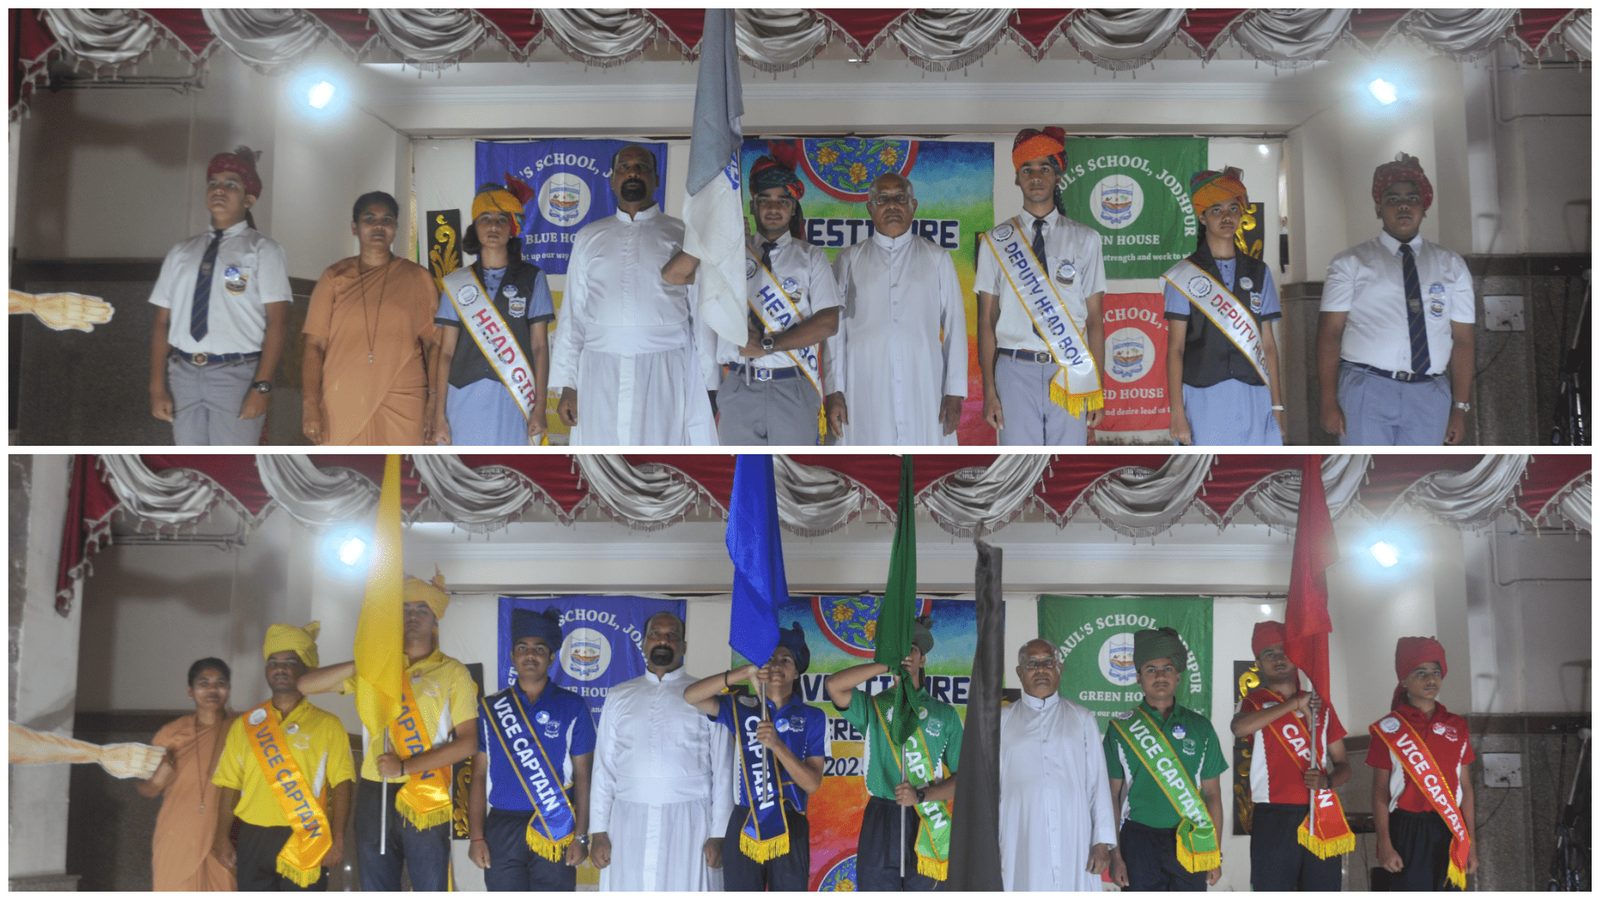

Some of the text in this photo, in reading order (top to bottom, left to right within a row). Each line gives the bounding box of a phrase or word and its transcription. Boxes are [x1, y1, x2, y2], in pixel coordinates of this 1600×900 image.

[535, 153, 600, 175] SCHOOL,
[1087, 155, 1153, 176] SCHOOL,
[1156, 169, 1197, 237] JODHPUR
[525, 232, 557, 245] BLUE
[1117, 234, 1160, 245] HOUSE
[1137, 252, 1151, 260] and
[756, 284, 793, 328] HEA
[1004, 242, 1083, 367] DEPUTY HEAD BOY
[1103, 307, 1163, 329] CHOOL,
[1210, 293, 1256, 342] DEPUTY
[472, 308, 516, 365] HEAD
[1120, 388, 1164, 399] HOUSE
[1096, 614, 1160, 631] SCHOOL
[1079, 690, 1121, 702] GREEN
[493, 696, 561, 812] VICE CAPTAIN
[823, 756, 864, 777] 202
[255, 725, 323, 840] VICE CAPTAIN
[1128, 719, 1164, 759] VICE
[1156, 757, 1208, 828] CAPTAIN
[1395, 732, 1466, 842] VICE CAPTAIN
